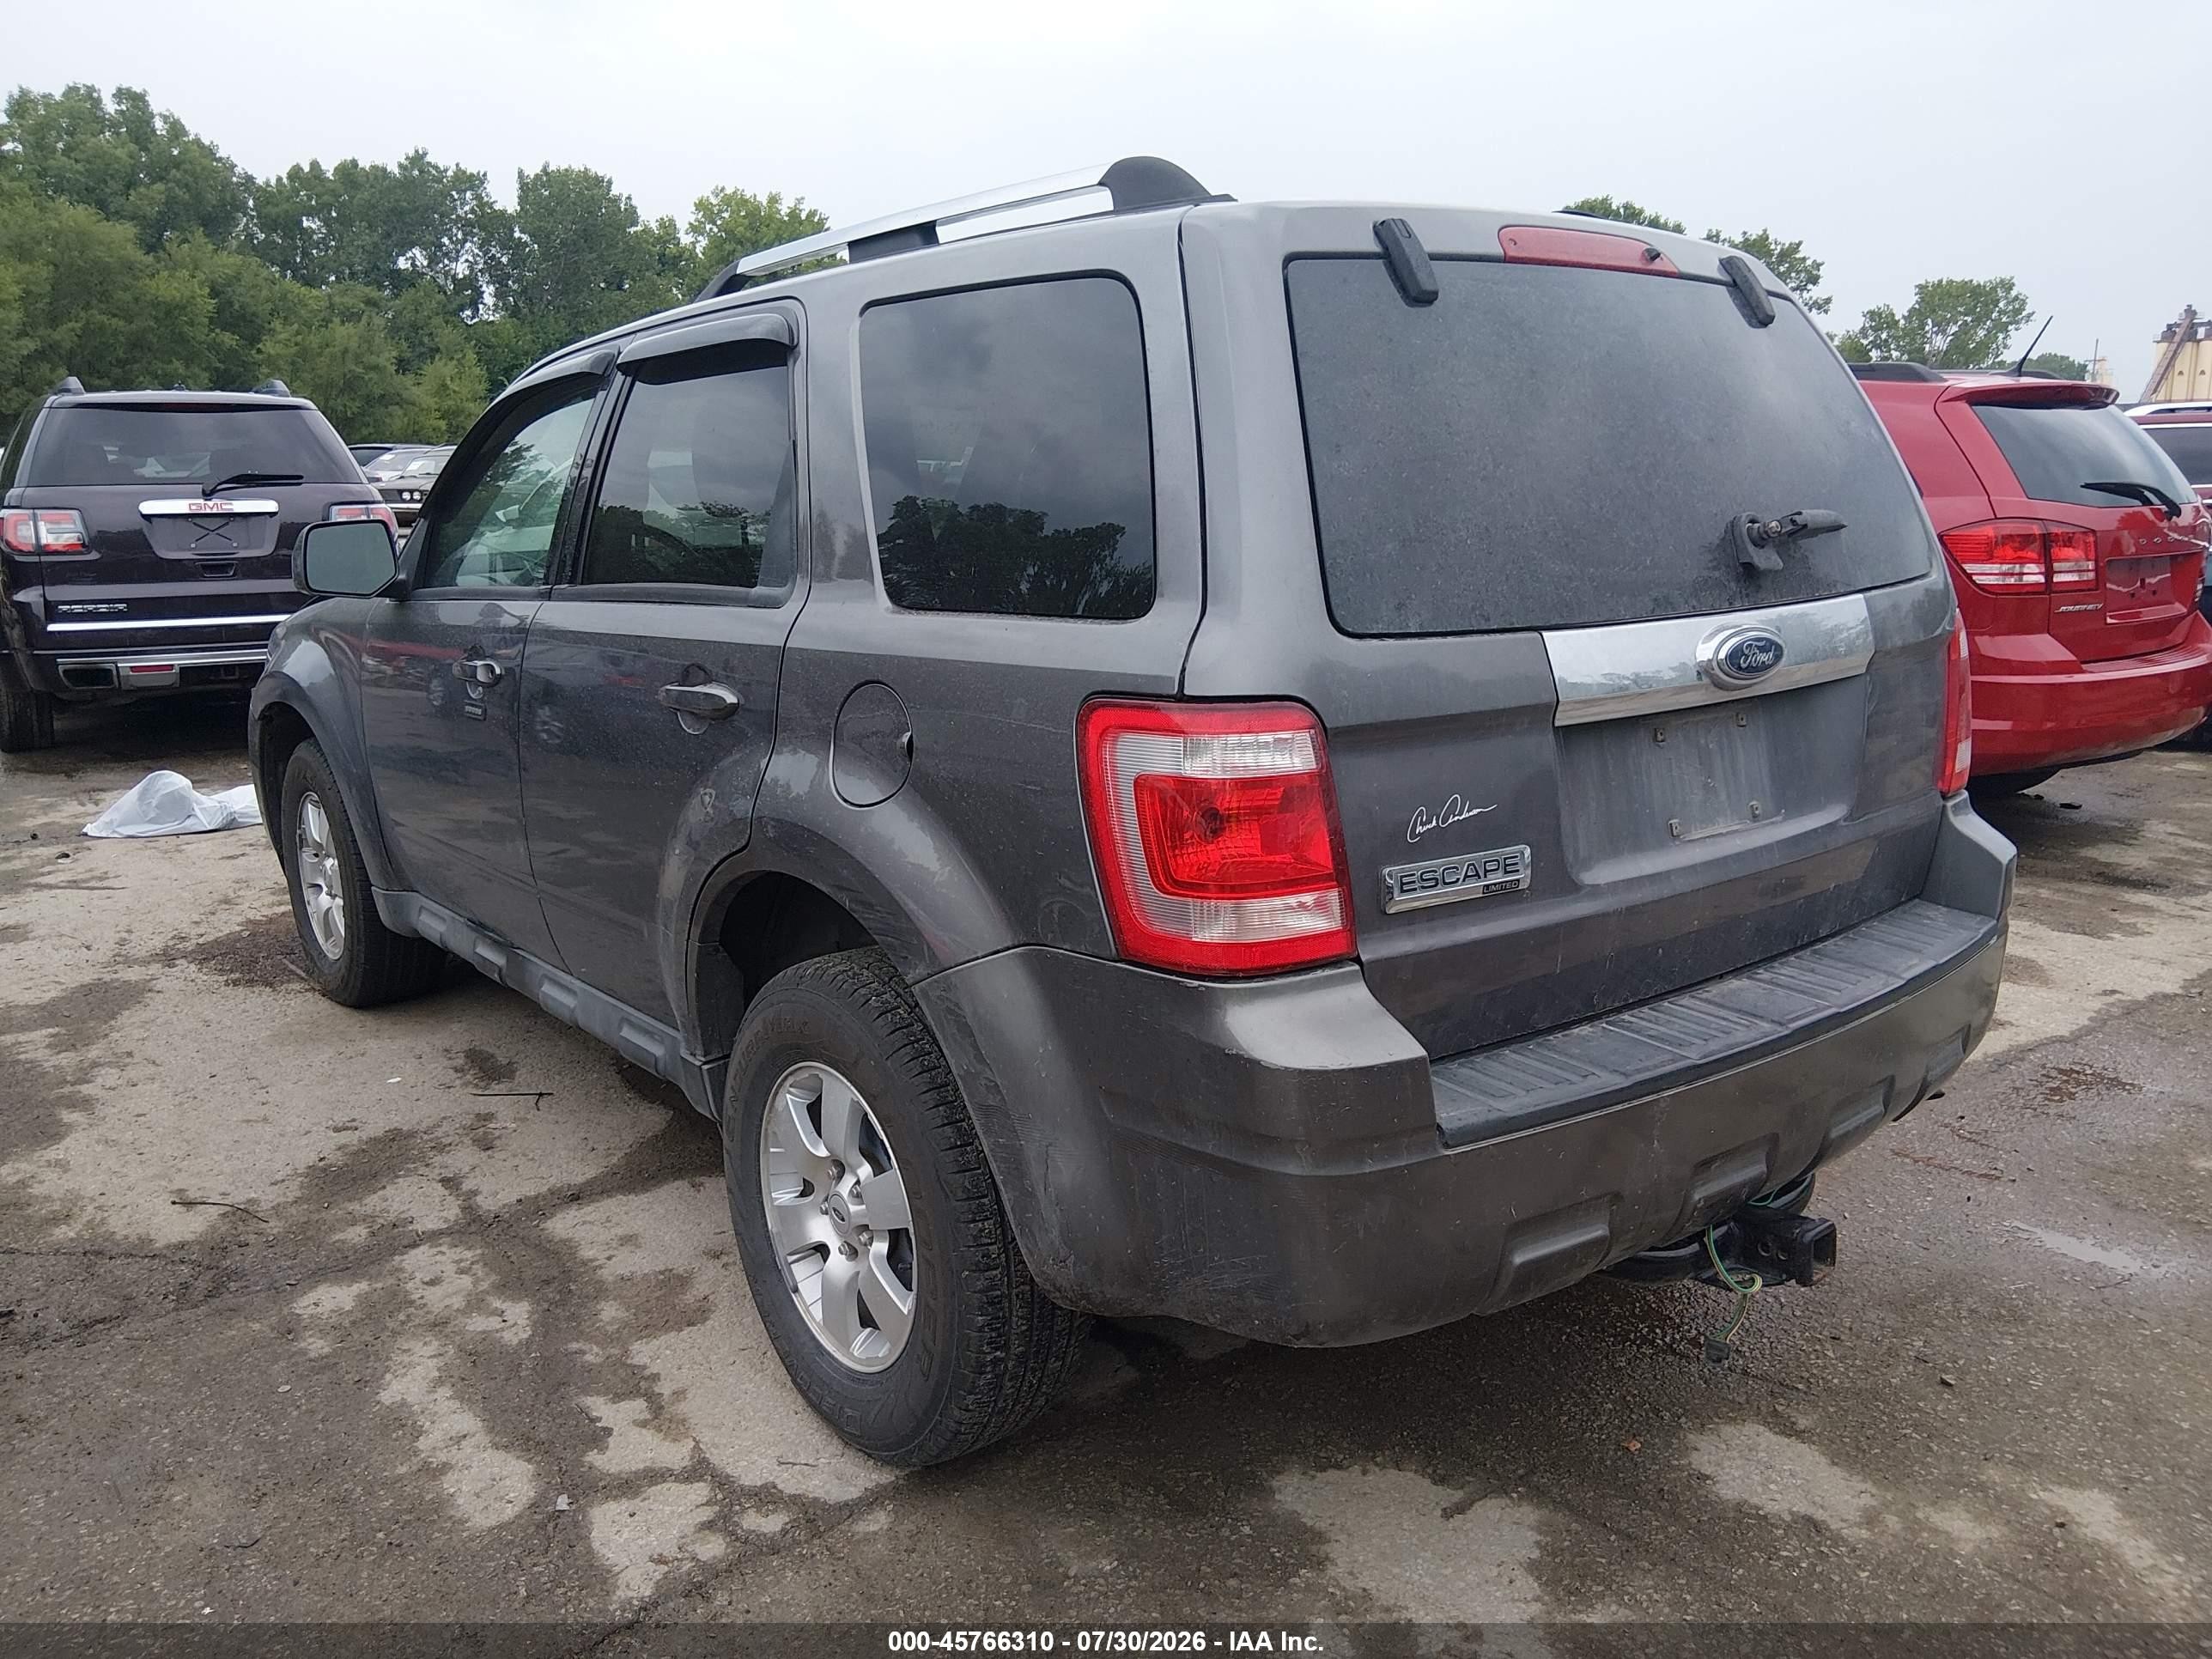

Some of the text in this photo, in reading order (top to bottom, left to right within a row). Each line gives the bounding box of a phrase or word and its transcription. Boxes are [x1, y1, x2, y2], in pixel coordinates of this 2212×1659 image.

[188, 502, 234, 512] GMC
[58, 604, 128, 613] ACADIA
[2055, 603, 2104, 613] JOURNEY
[1740, 640, 1776, 669] Ford
[1407, 805, 1437, 843] Chuck
[1399, 854, 1520, 894] ESCAPE
[1482, 880, 1519, 894] LIMITED
